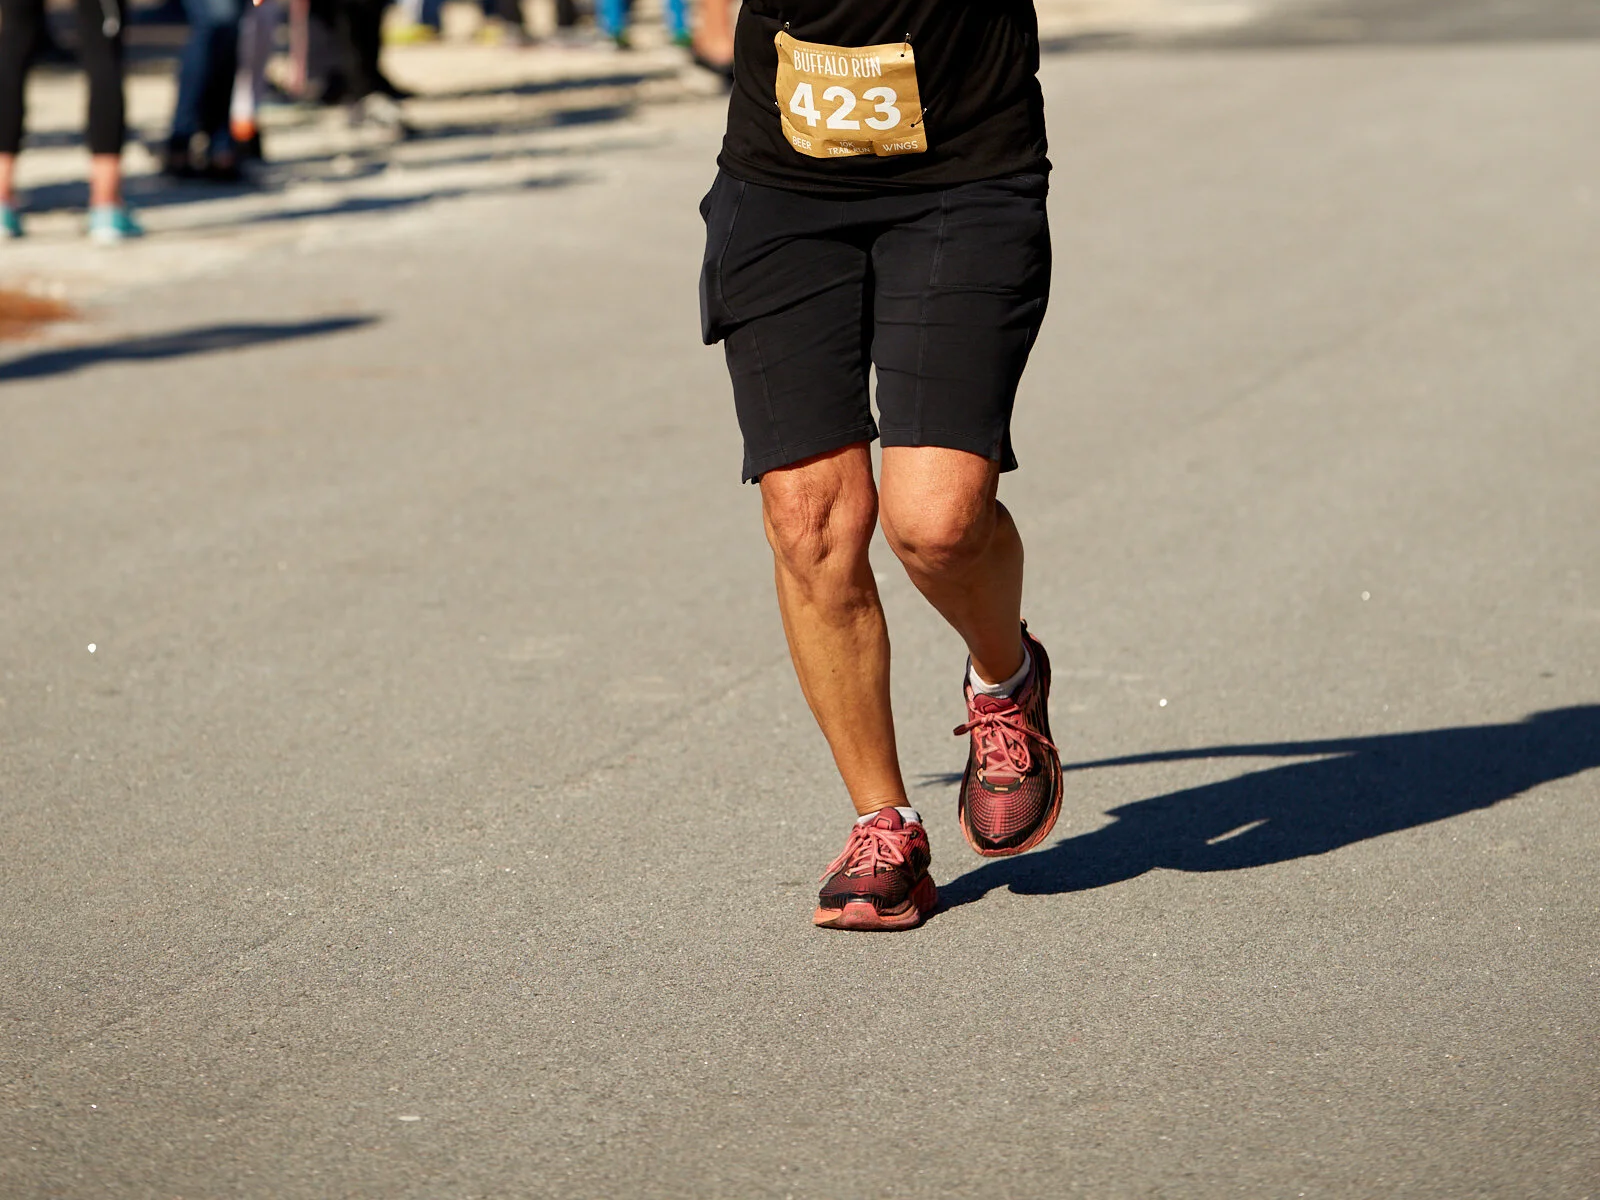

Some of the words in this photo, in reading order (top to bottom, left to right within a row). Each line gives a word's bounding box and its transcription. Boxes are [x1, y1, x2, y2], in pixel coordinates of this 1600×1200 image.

[793, 50, 849, 77] BUFFALO
[851, 56, 882, 78] RUN
[789, 82, 901, 131] 423
[792, 135, 812, 151] BEER
[827, 147, 851, 155] TRAIL
[882, 140, 919, 152] WINGS
